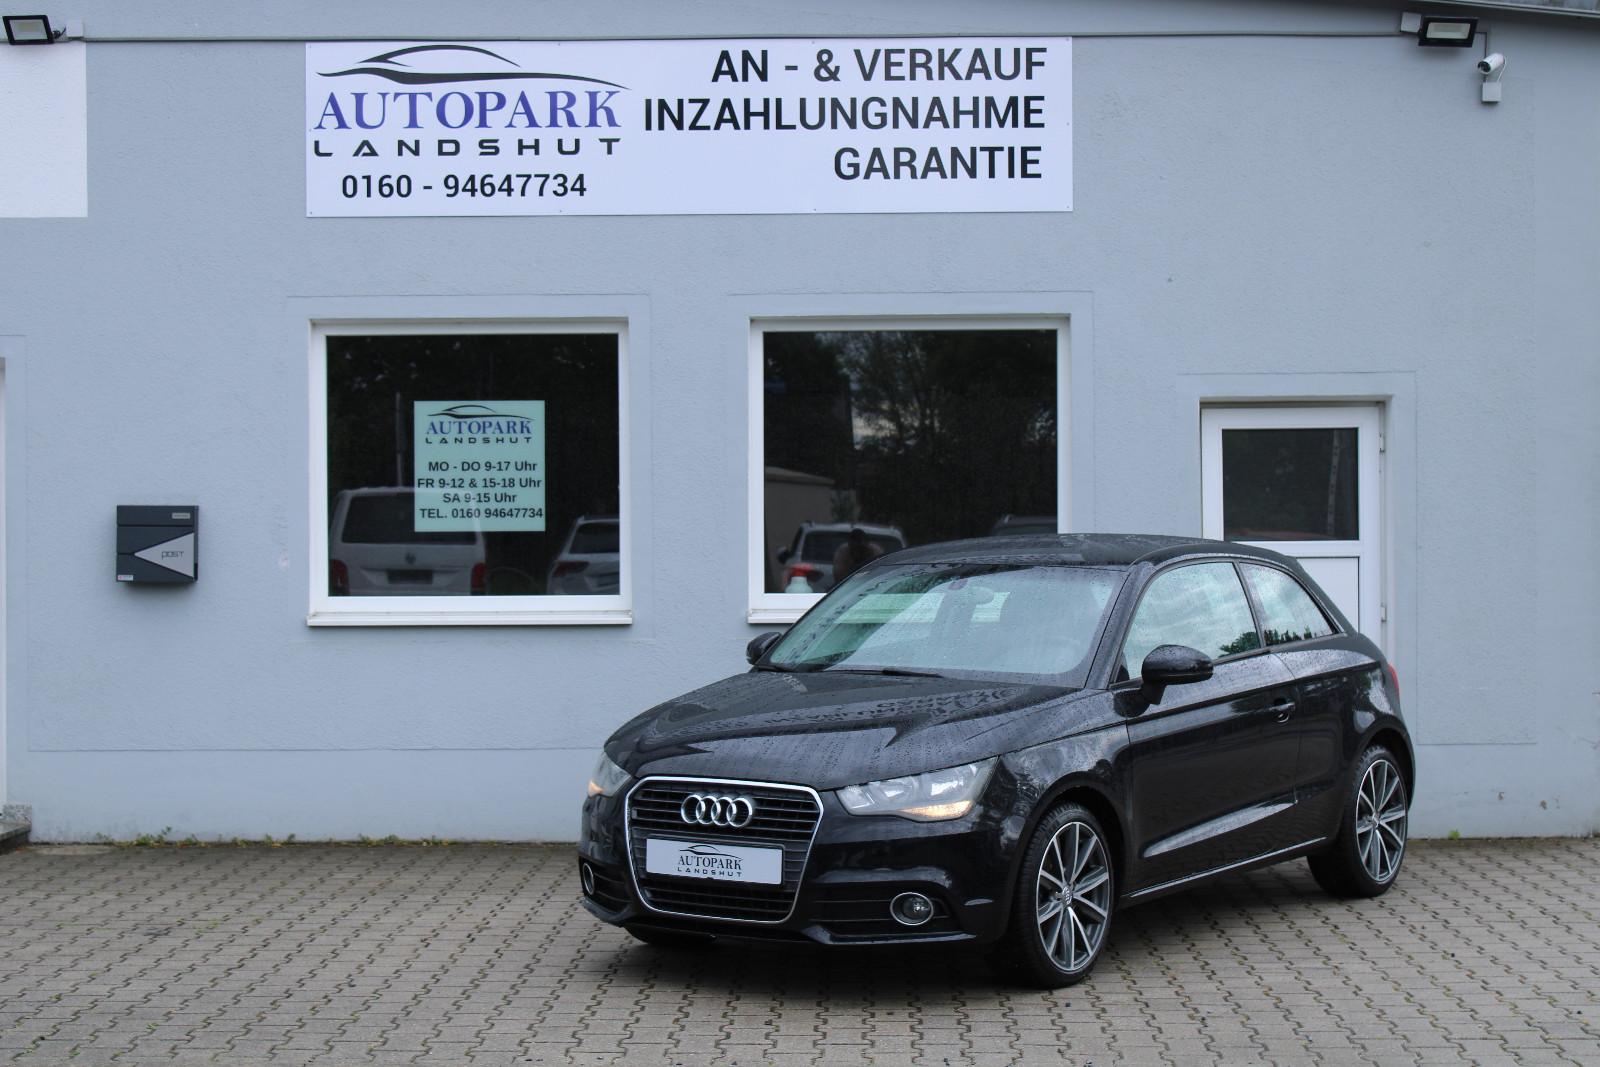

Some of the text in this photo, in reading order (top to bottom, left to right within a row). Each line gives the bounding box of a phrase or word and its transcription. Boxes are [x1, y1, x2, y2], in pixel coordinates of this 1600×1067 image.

[712, 50, 768, 82] AN
[813, 49, 841, 82] &
[854, 47, 1047, 81] VERKAUF
[313, 90, 622, 130] AUTOPARK
[644, 95, 1045, 131] INZAHLUNGNAHME
[314, 138, 621, 157] LANDSHUT
[834, 146, 1042, 180] GARANTIE
[342, 174, 412, 198] 0160
[443, 173, 587, 198] 94647734
[426, 420, 532, 435] AUTOPARK
[428, 461, 449, 471] MO
[461, 461, 480, 471] DO
[484, 461, 511, 471] 9-17
[515, 461, 537, 471] Uhr
[417, 478, 542, 488] FR 9-12 & 15-18 Uhr
[442, 492, 517, 503] SA 9-15 Uhr
[420, 508, 543, 518] TEL. 0160 94647734
[678, 855, 743, 870] AUTOPARK
[677, 867, 743, 877] LANDSHUT
